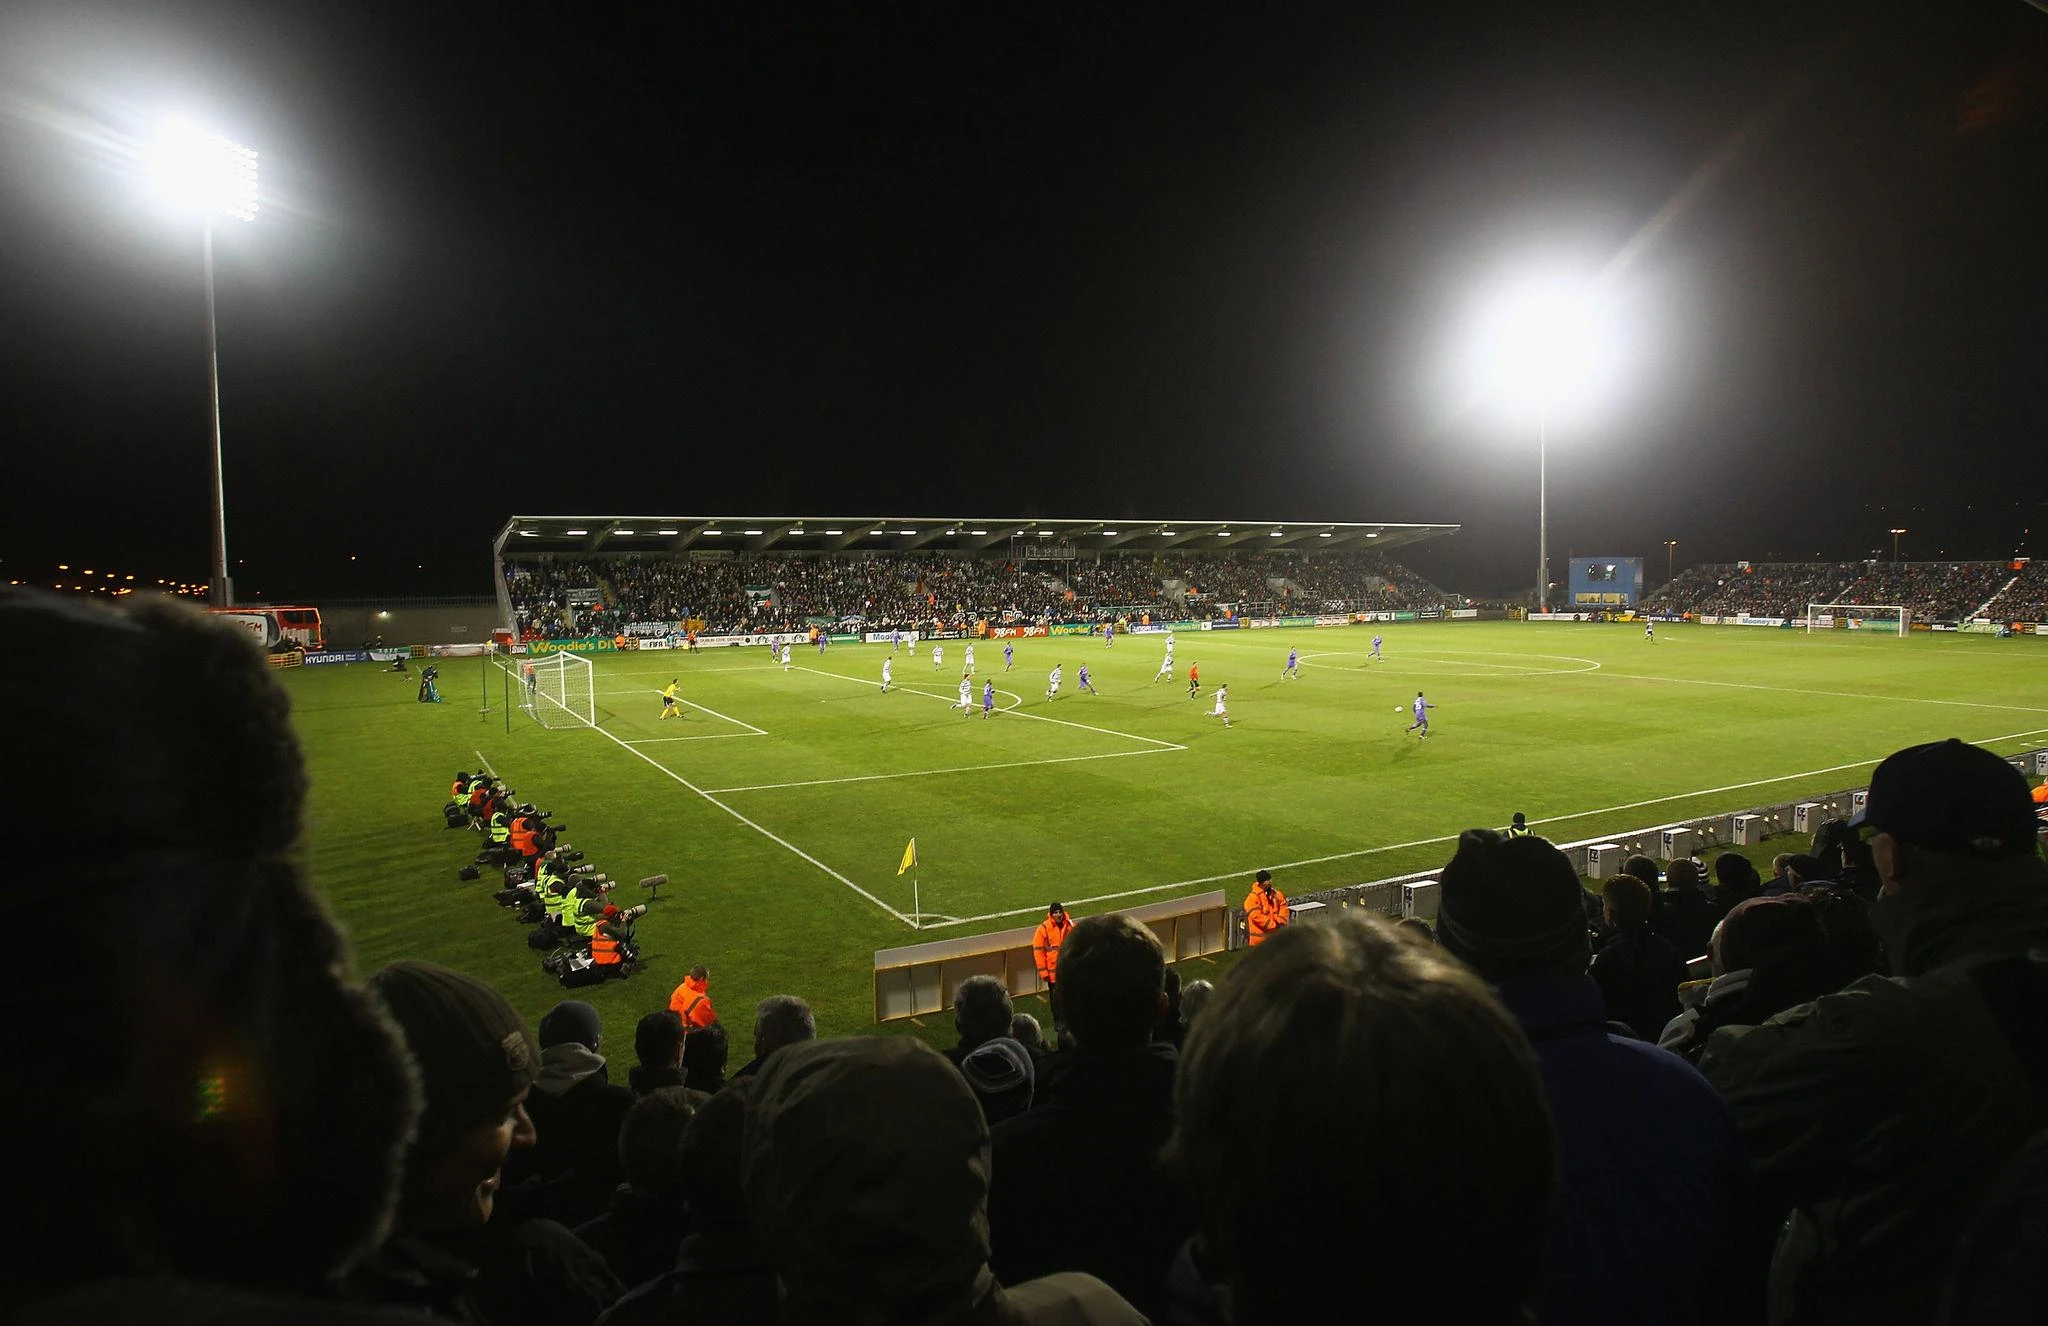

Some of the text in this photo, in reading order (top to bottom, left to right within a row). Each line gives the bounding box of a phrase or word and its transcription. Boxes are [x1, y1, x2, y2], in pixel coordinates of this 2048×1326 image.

[993, 627, 1016, 639] 98FM
[1023, 626, 1045, 638] 98FM
[529, 641, 594, 653] Woodie's
[305, 654, 344, 664] HYUNDAI
